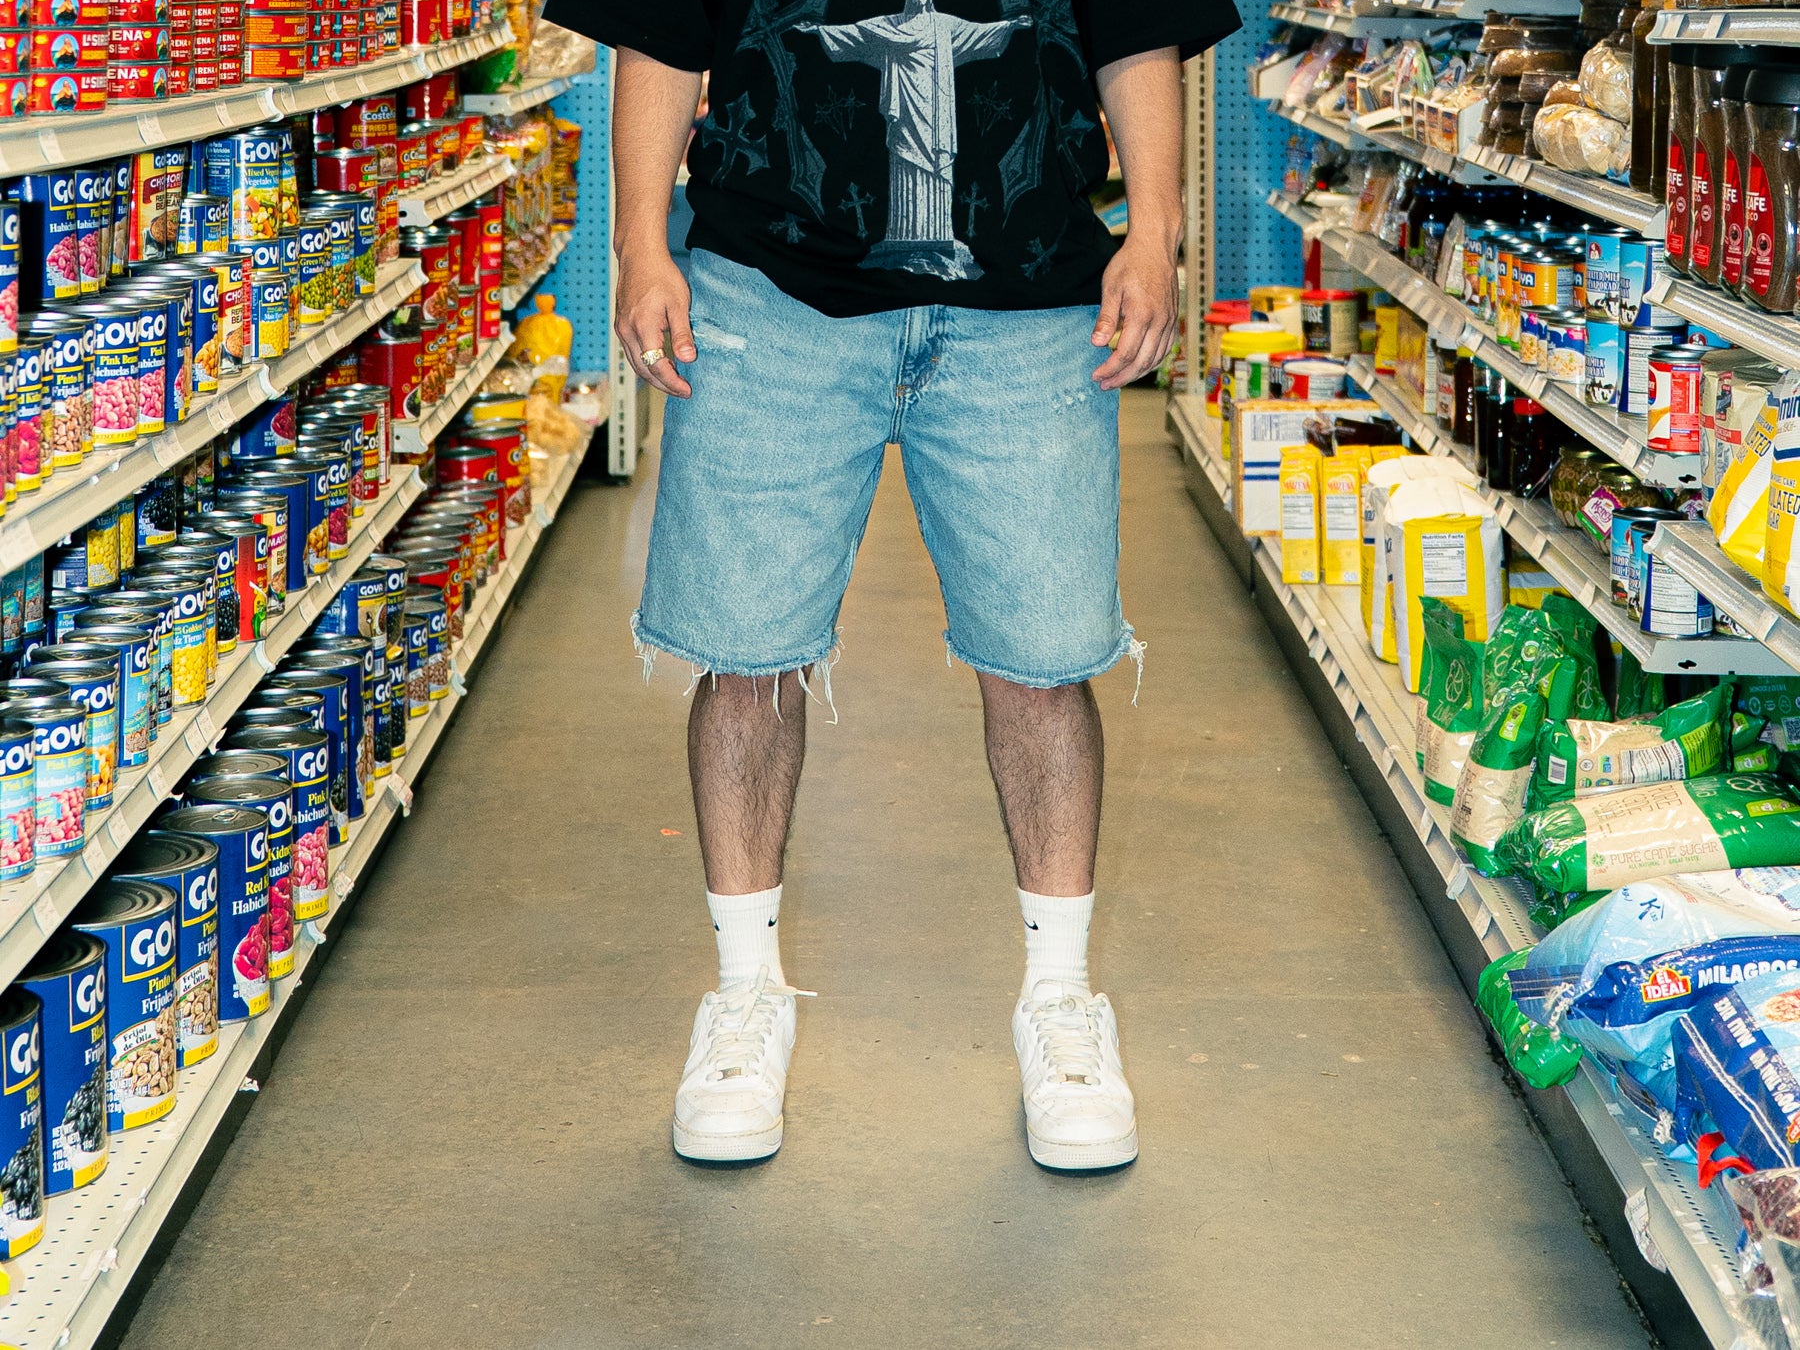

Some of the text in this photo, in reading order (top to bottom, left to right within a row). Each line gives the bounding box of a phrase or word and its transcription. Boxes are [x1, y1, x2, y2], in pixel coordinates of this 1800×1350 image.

[352, 124, 387, 132] REFRIED
[0, 743, 34, 775] OY
[1656, 971, 1671, 985] EL
[1645, 981, 1687, 1000] IDEAL
[123, 1024, 148, 1043] Frijol
